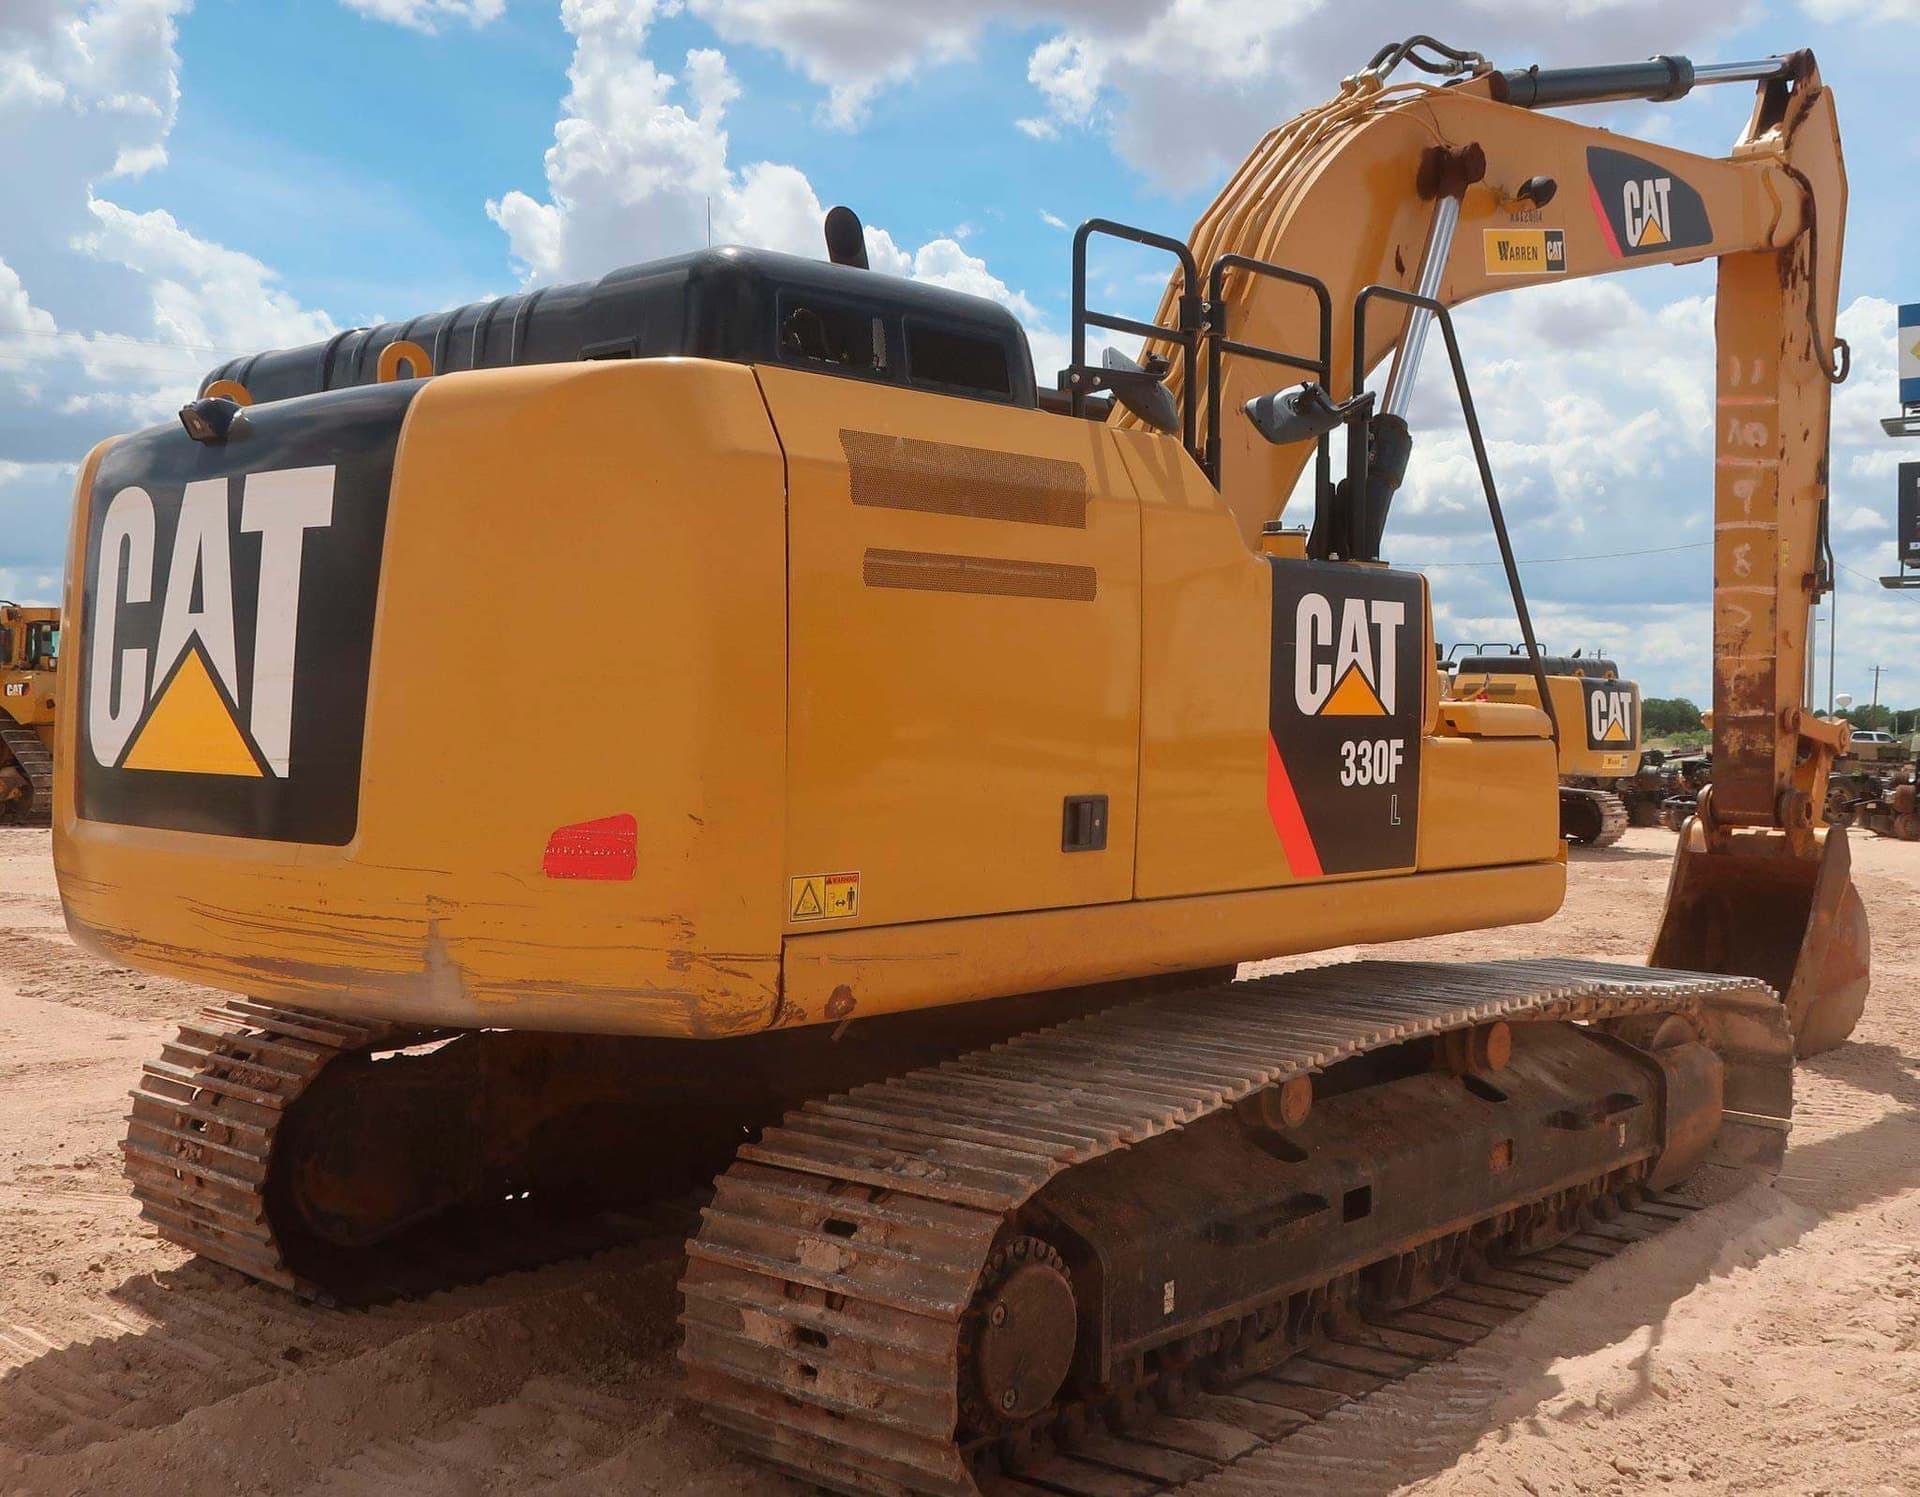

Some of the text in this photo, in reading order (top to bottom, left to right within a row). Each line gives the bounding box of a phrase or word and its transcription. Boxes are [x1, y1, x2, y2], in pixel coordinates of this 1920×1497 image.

[1623, 177, 1671, 248] CAT
[1547, 240, 1563, 261] CAT
[89, 464, 336, 778] CAT
[1294, 592, 1405, 716] CAT
[6, 683, 24, 697] CAT
[1591, 690, 1632, 741] CAT
[1340, 739, 1405, 787] 330F
[1391, 794, 1401, 826] L
